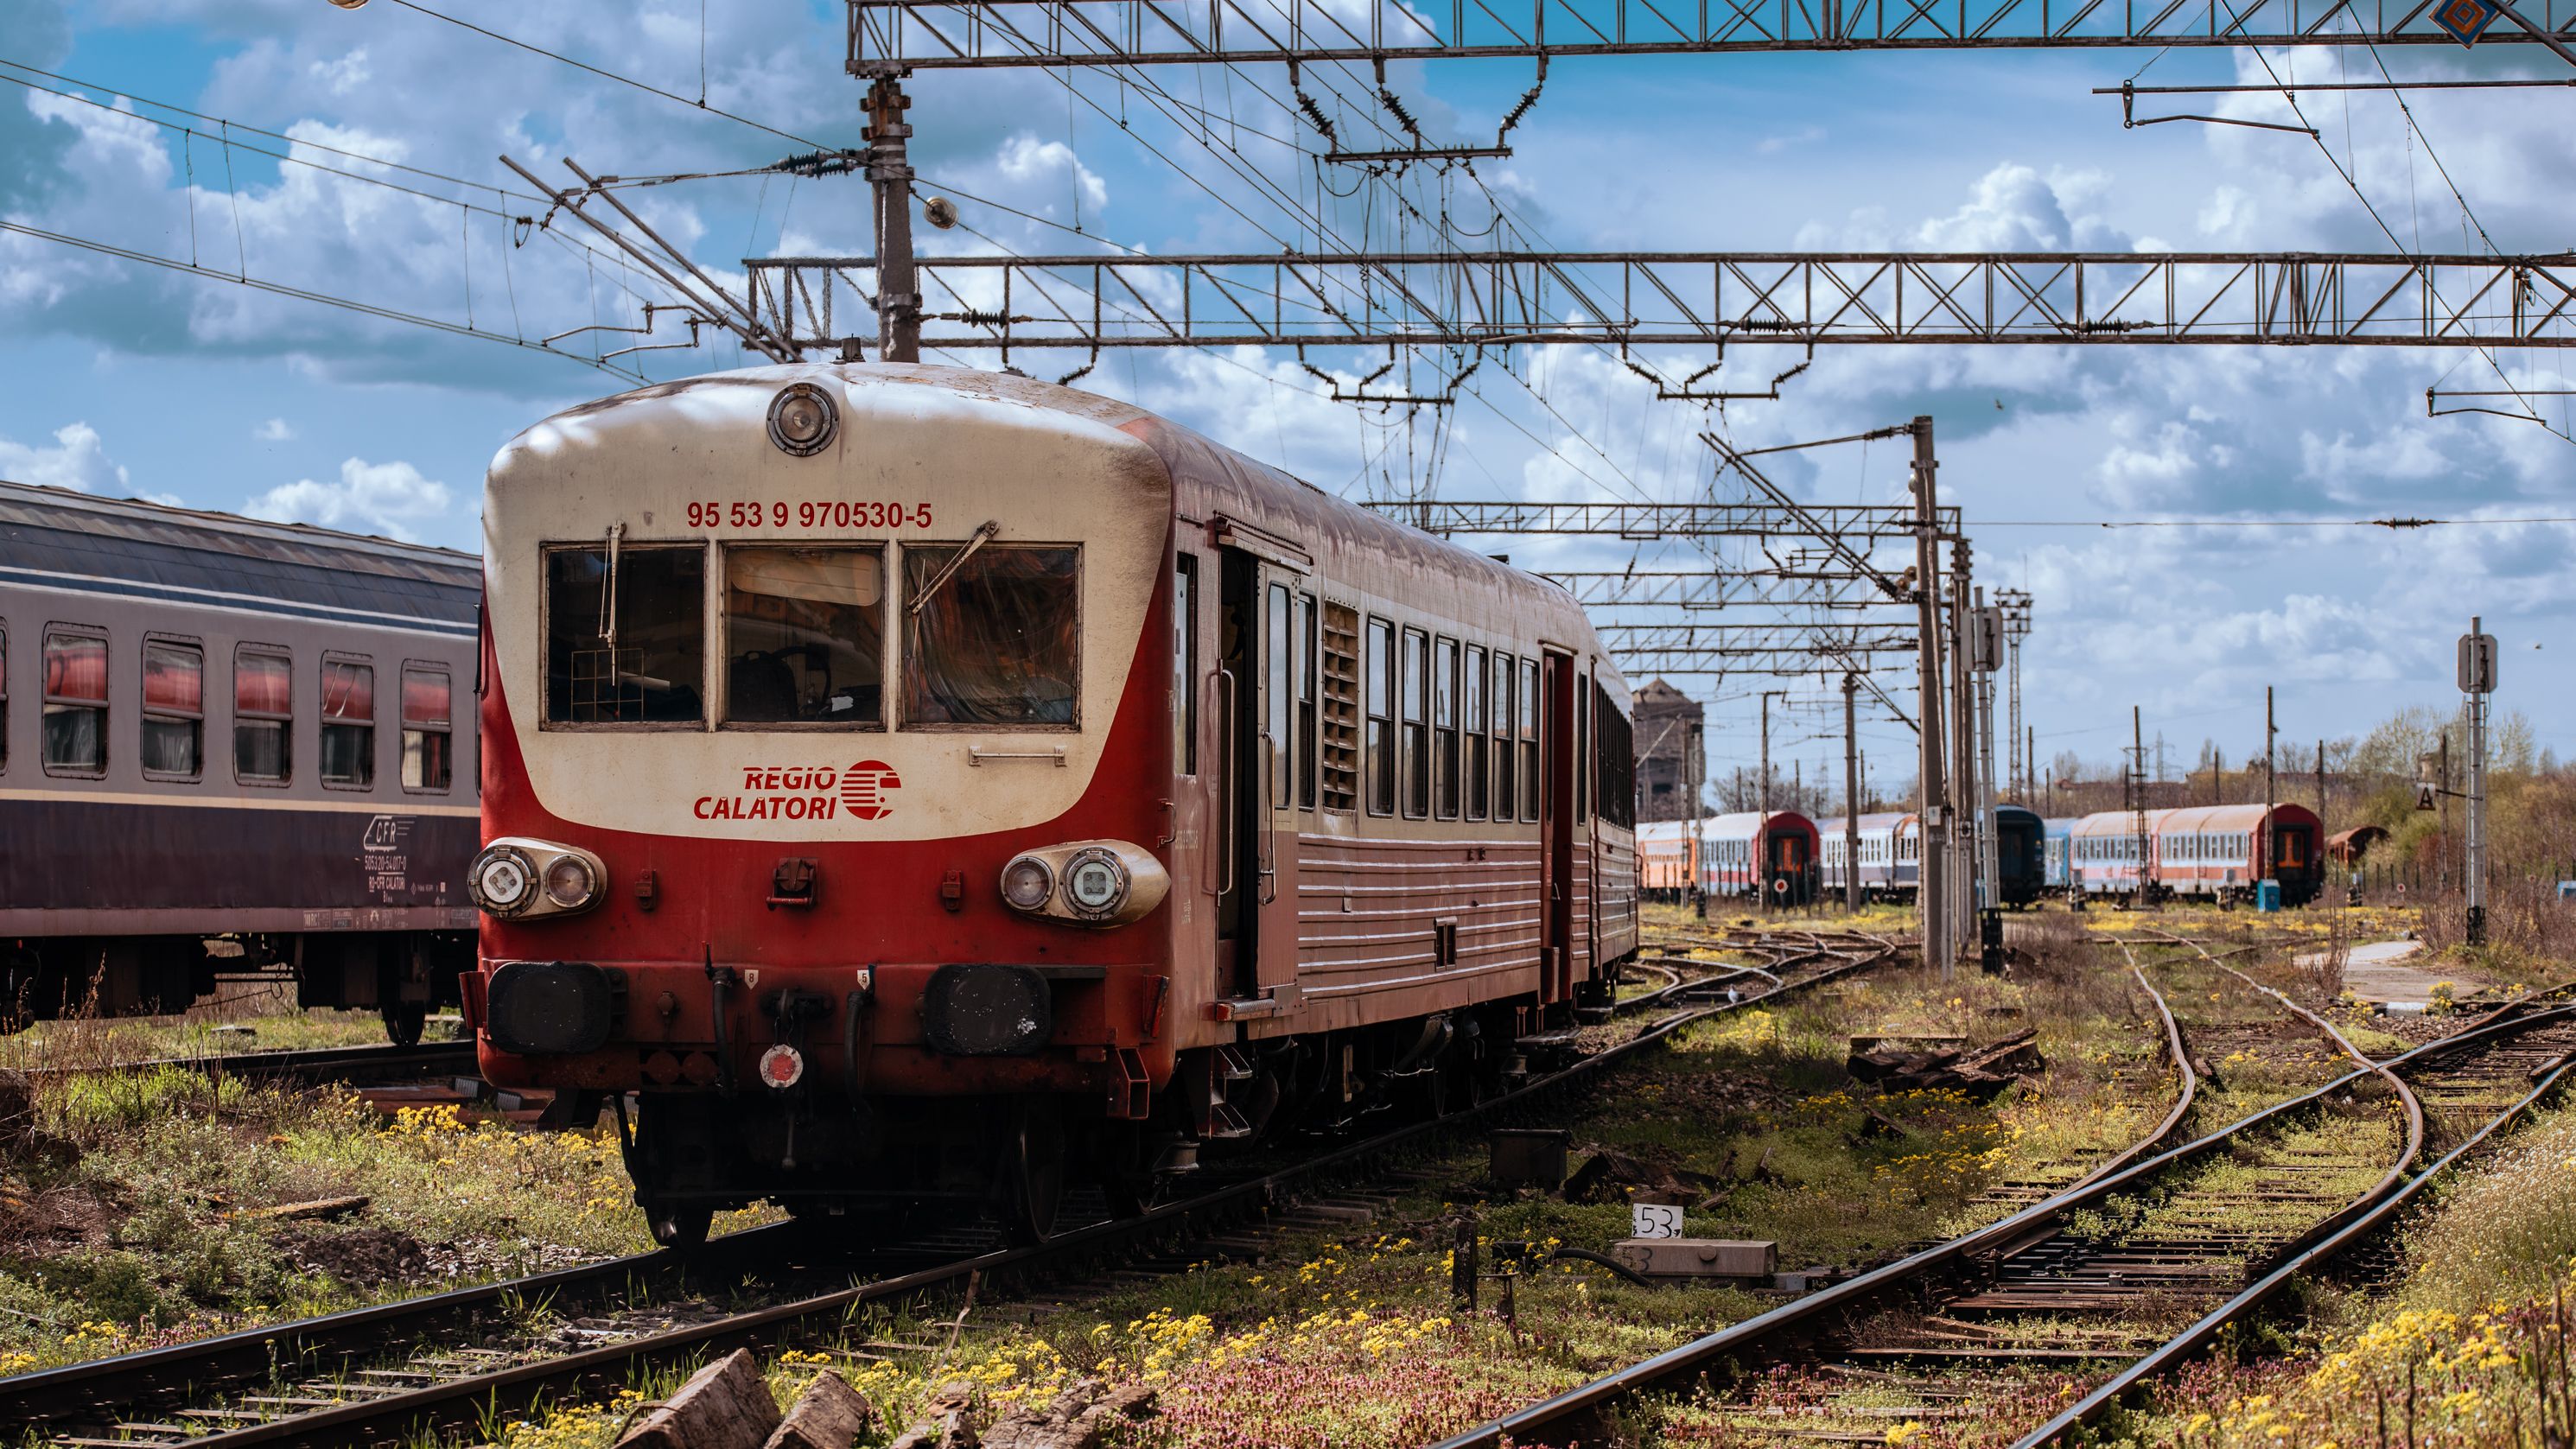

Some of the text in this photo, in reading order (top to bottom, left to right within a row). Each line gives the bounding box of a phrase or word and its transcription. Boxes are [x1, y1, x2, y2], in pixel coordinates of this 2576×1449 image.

[687, 501, 932, 528] 95 53 9 970530-5
[742, 766, 836, 790] REGIO
[2420, 786, 2433, 807] A
[376, 822, 397, 843] CFR
[748, 973, 754, 983] 8
[862, 973, 868, 983] 5
[1641, 1206, 1673, 1238] 53
